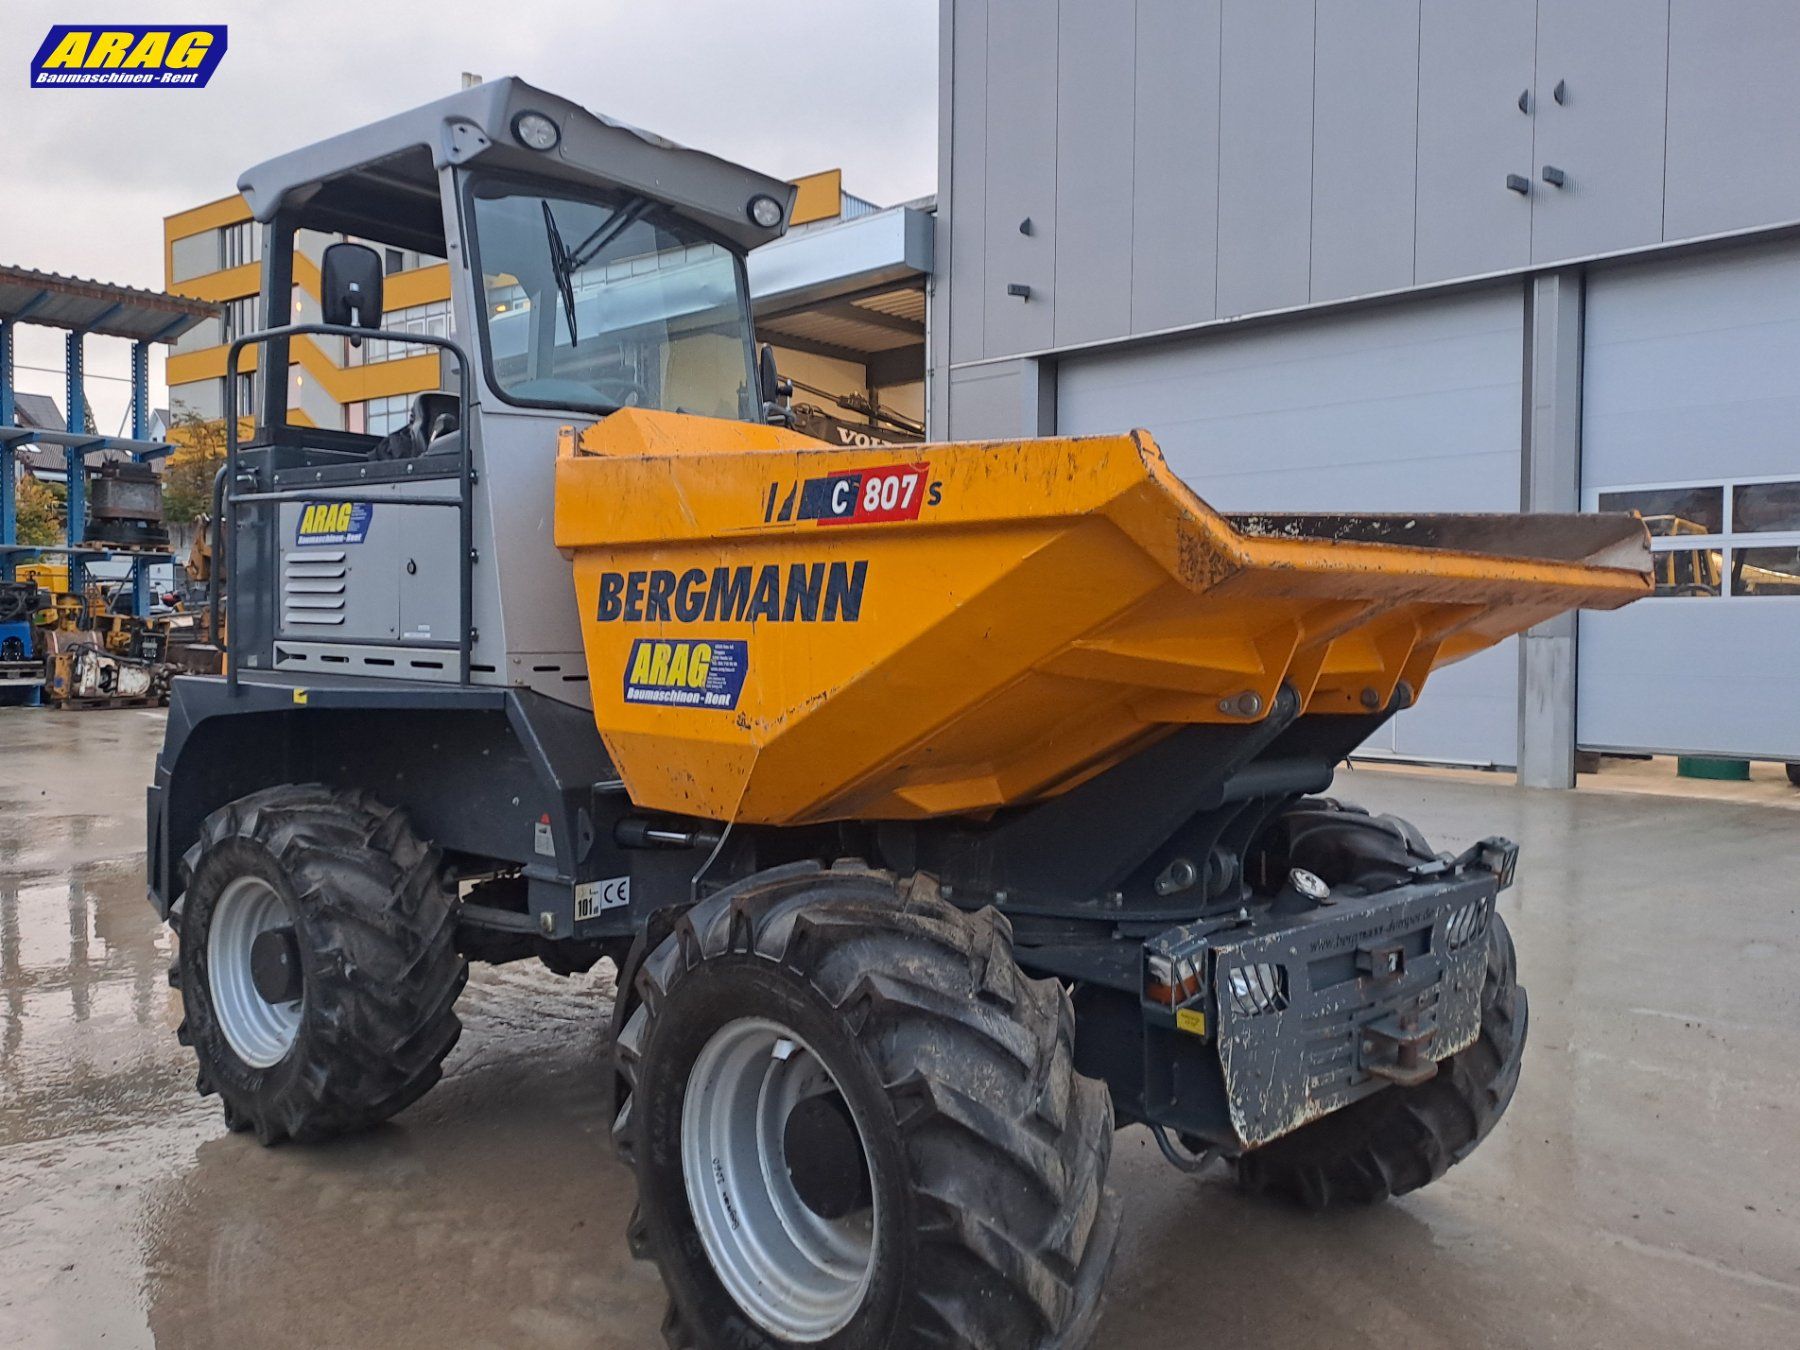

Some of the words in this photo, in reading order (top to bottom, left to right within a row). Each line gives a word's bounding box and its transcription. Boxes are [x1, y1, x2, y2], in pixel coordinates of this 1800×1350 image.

[836, 426, 893, 448] VOL
[831, 480, 850, 514] C
[863, 474, 918, 512] 807
[300, 502, 353, 534] ARAG
[597, 560, 869, 623] BERGMANN
[629, 643, 712, 688] ARAG
[578, 898, 592, 917] 101
